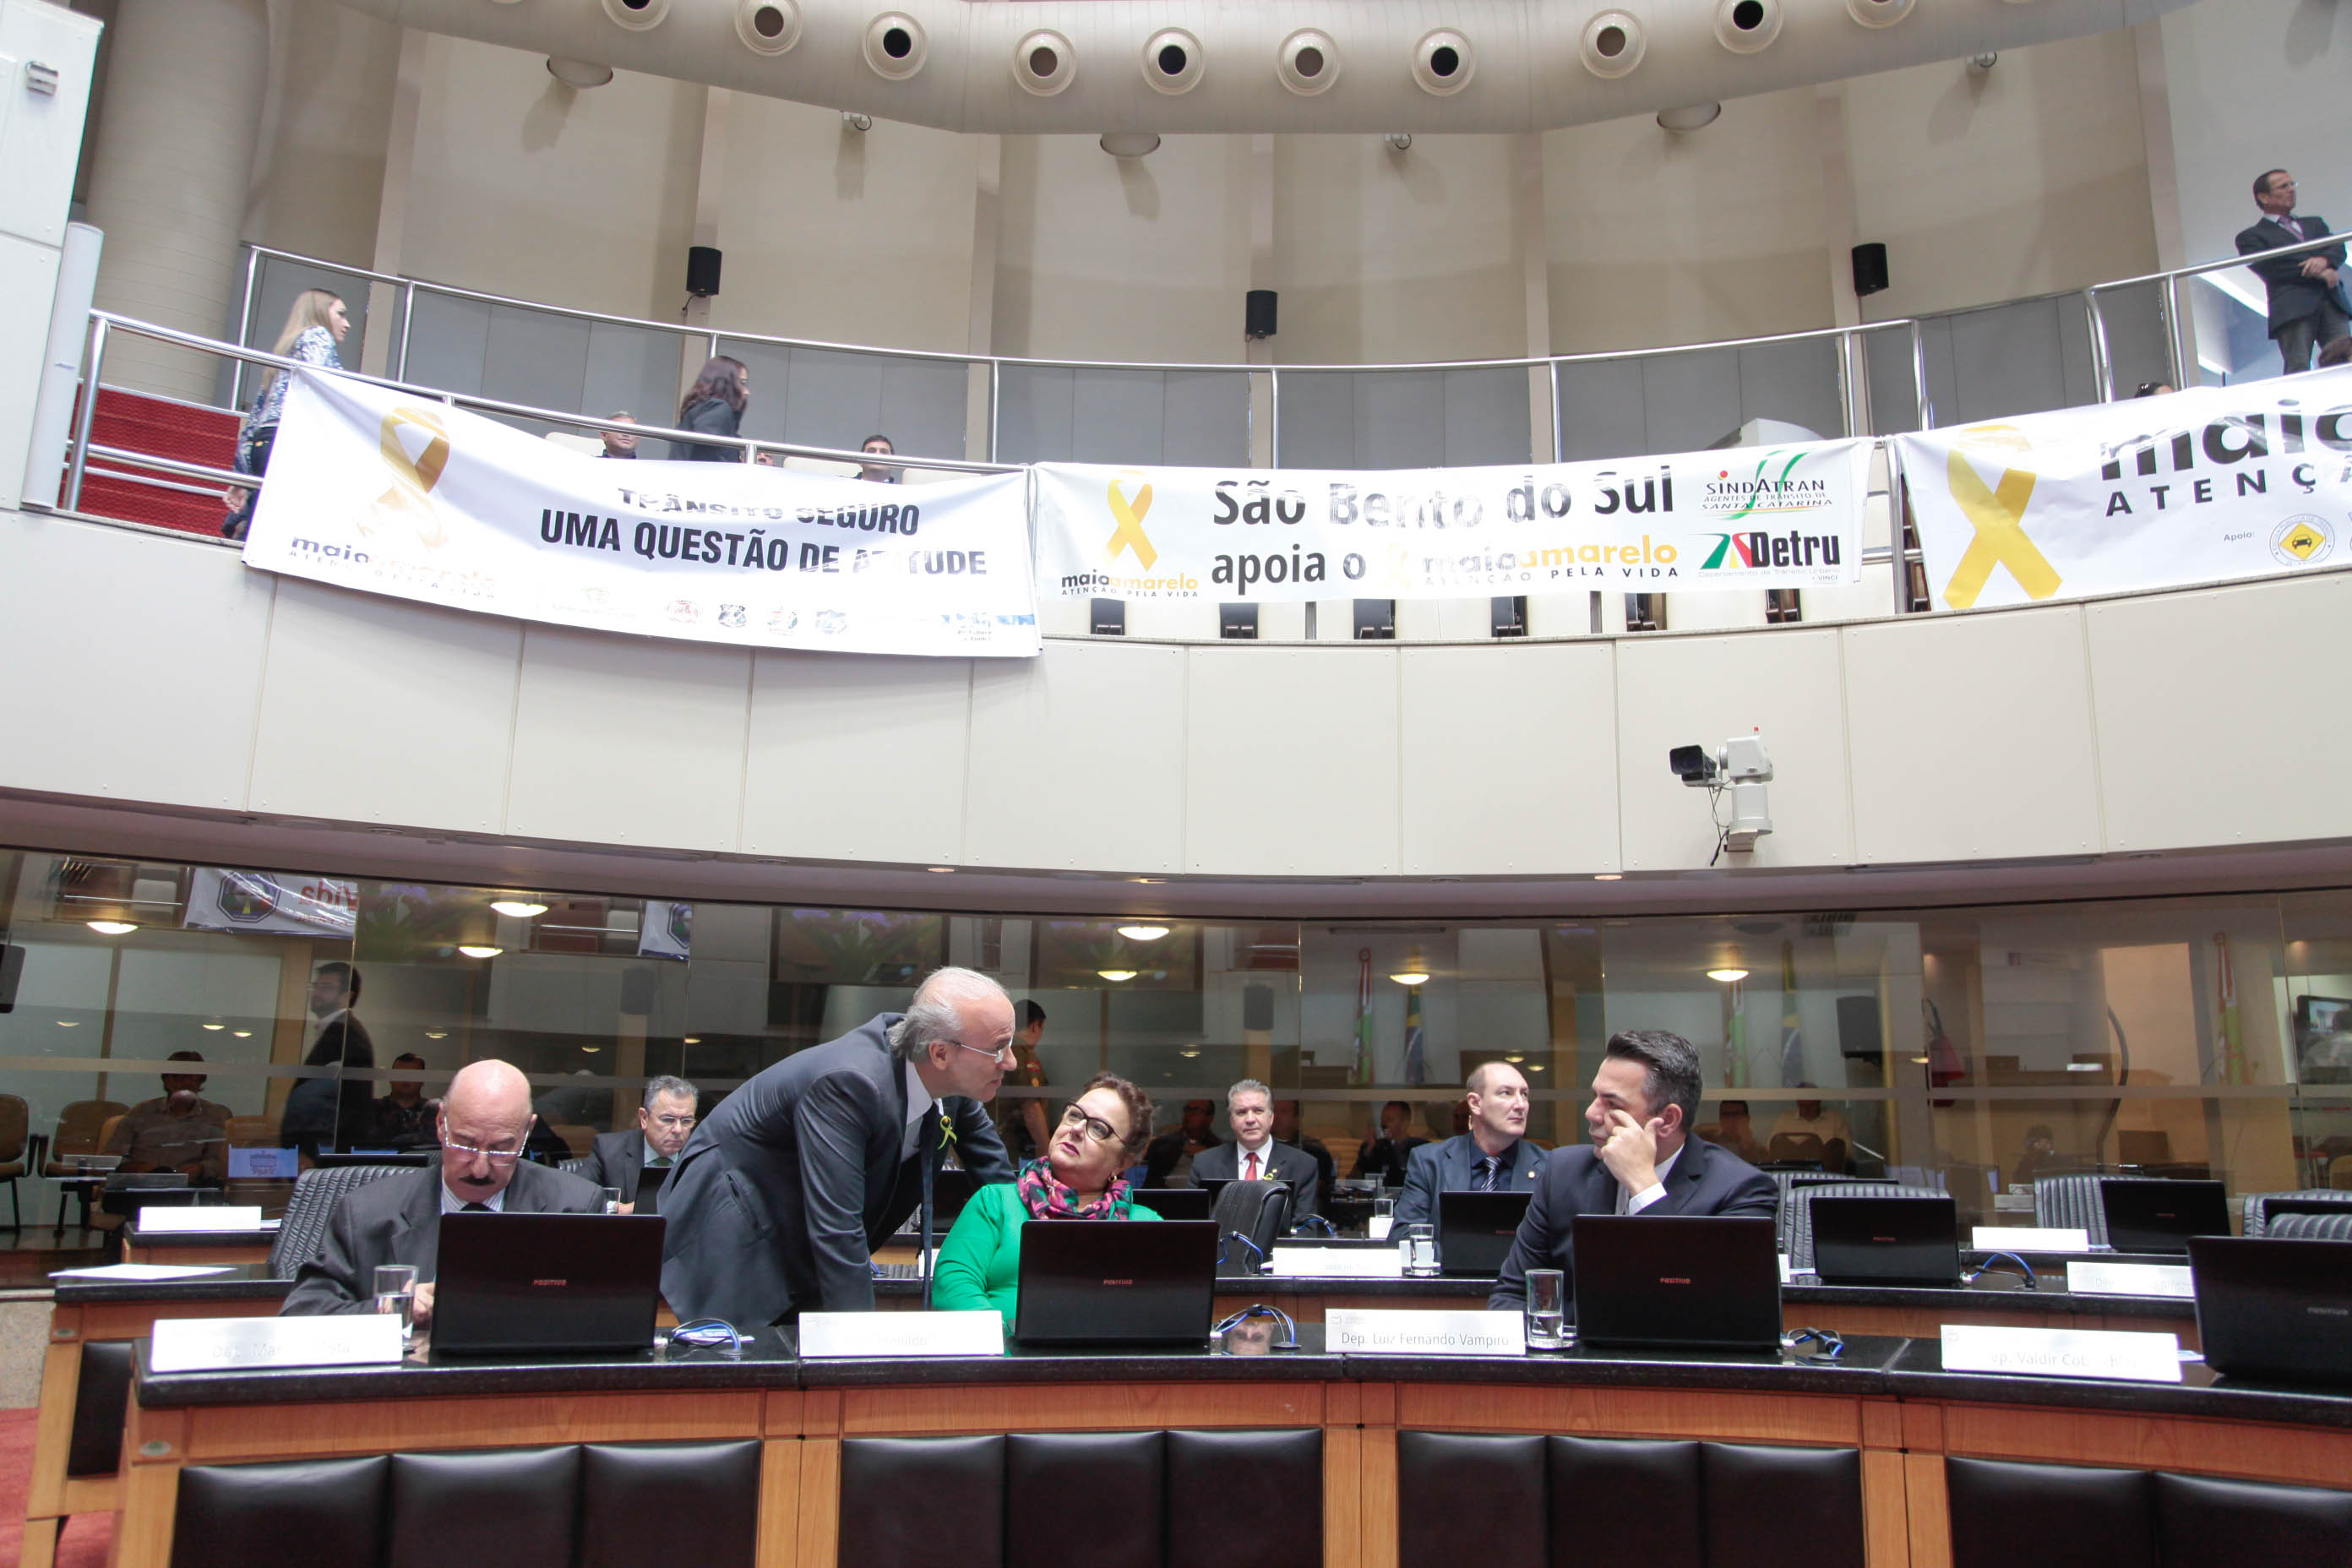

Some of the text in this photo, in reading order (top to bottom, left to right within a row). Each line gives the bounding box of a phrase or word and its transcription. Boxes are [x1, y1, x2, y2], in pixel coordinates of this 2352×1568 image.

[1213, 465, 1674, 530] São Bento do Sul
[1707, 476, 1825, 494] SINDATRAN
[1757, 499, 1832, 508] CATARINA
[795, 504, 920, 536] SEGURO
[540, 509, 987, 574] UMA QUESTÃO DE ATUDE
[1750, 531, 1841, 568] Detru
[1211, 543, 1326, 595] apoia
[1342, 553, 1367, 580] o
[1550, 567, 1604, 580] PELA
[1621, 567, 1679, 578] VIDA
[1341, 1331, 1369, 1348] Dep.
[1400, 1331, 1456, 1346] Fernando
[1458, 1332, 1510, 1348] Vampiro
